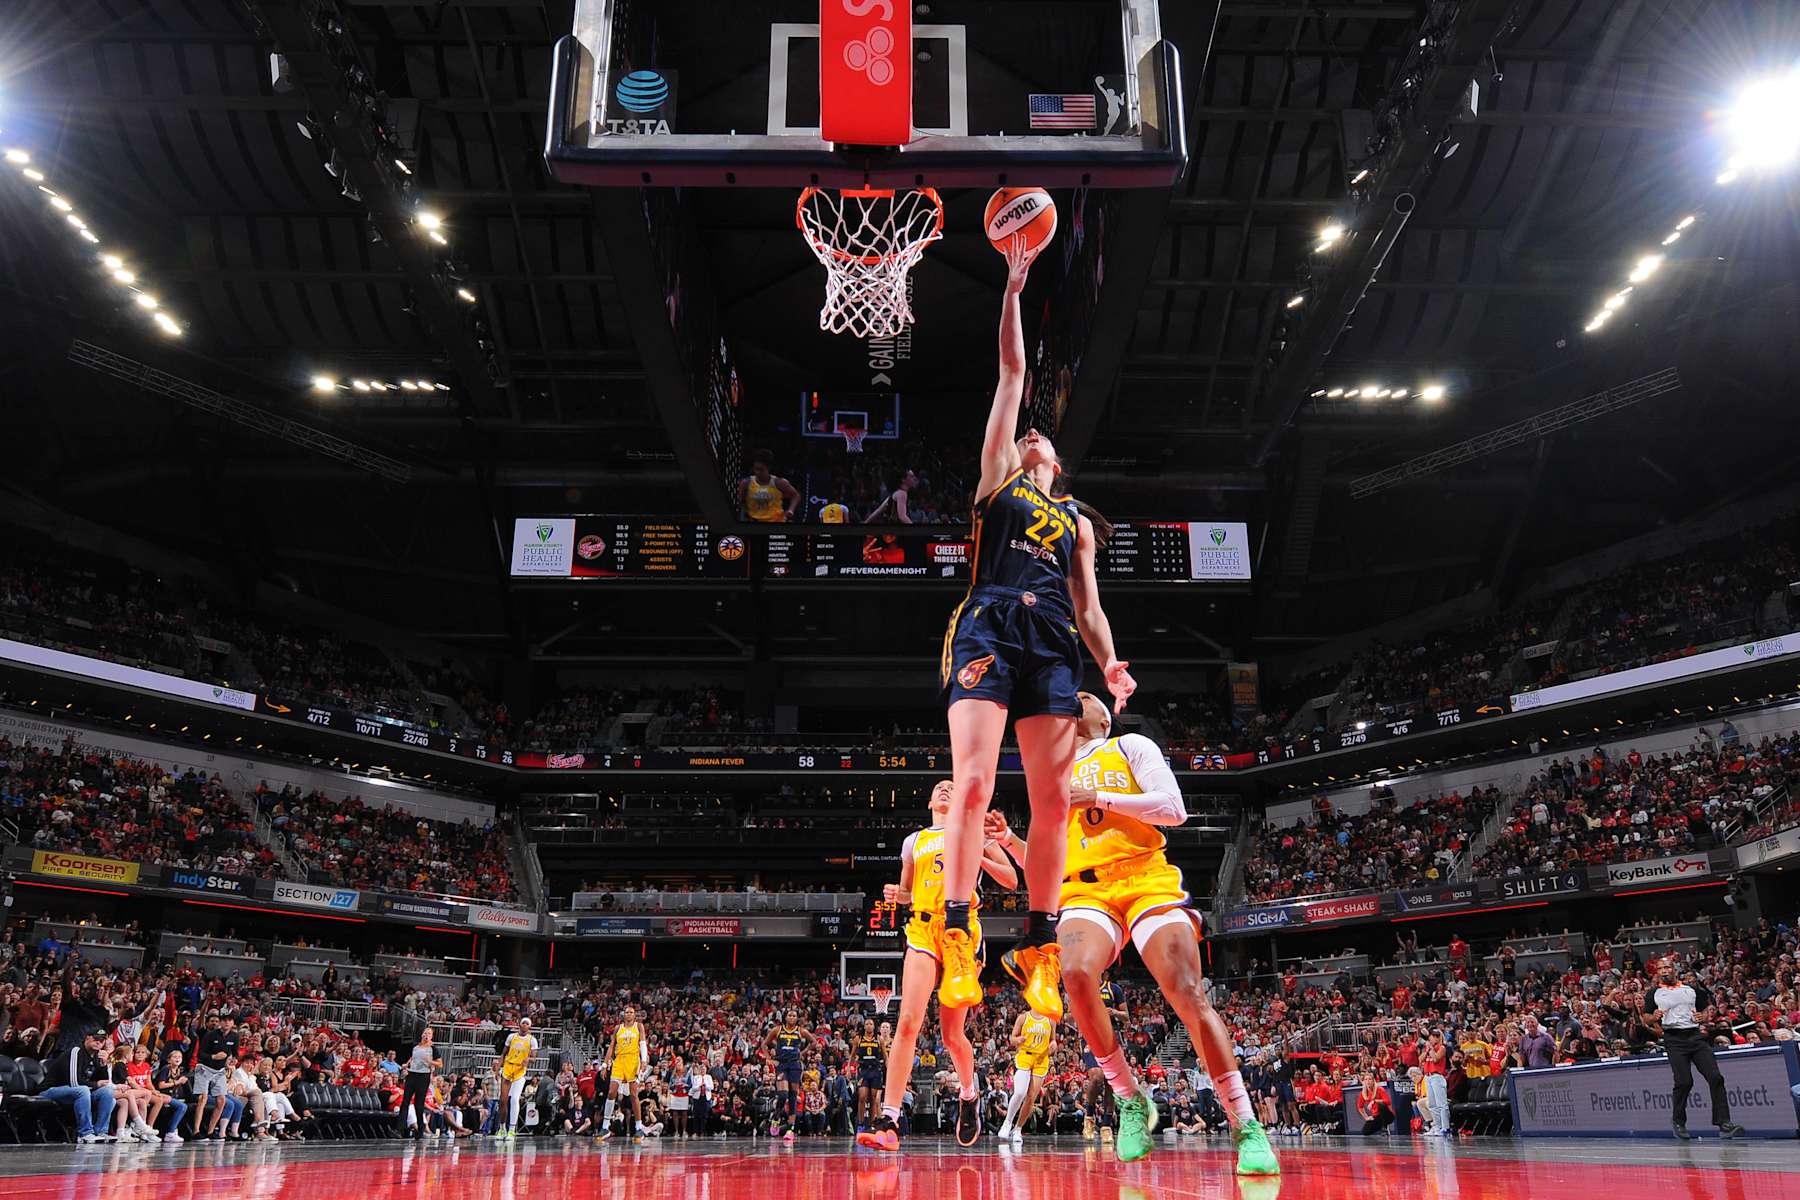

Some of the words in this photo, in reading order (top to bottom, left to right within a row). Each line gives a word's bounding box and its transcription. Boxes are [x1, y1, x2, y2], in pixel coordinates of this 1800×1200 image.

[994, 198, 1039, 230] Wilson
[1025, 509, 1065, 552] 22
[840, 567, 927, 575] #FEVERGAMENIGHT
[307, 713, 330, 725] 4/12
[1438, 714, 1460, 726] 7/16
[355, 723, 381, 736] 10/11
[1392, 725, 1408, 735] 4/6
[402, 733, 429, 746] 22/40
[1340, 734, 1367, 746] 22/49
[450, 744, 456, 752] 2
[476, 749, 486, 759] 13
[1314, 744, 1320, 752] 5
[502, 755, 513, 764] 26
[1258, 755, 1268, 764] 14
[1285, 750, 1295, 759] 11
[689, 758, 720, 766] INDIANA
[721, 758, 745, 766] FEVER
[798, 756, 814, 767] 58
[841, 759, 851, 768] 22
[879, 756, 907, 768] 5:54
[928, 760, 935, 768] 3
[1086, 807, 1104, 826] 0
[44, 854, 127, 874] Koorsen
[933, 853, 945, 874] 5
[41, 865, 62, 873] FIRE
[79, 870, 125, 880] SECURITY
[1609, 864, 1672, 881] KeyBank
[1503, 876, 1559, 896] SHIFT
[1567, 876, 1575, 886] 4
[277, 887, 333, 902] SECTION
[334, 894, 352, 905] 127
[874, 900, 897, 911] 5:53
[1306, 909, 1336, 918] STEAK
[1343, 901, 1376, 913] SHAKE
[478, 908, 507, 925] Bally
[508, 917, 530, 926] SPORTS
[870, 910, 895, 929] 21
[1223, 909, 1288, 928] SHIPSIGMA
[867, 1047, 872, 1056] 0
[1538, 1088, 1574, 1104] PUBLIC
[1590, 1091, 1642, 1113] Prevent.
[1540, 1102, 1576, 1118] HEALTH
[1542, 1117, 1577, 1127] DEPARTMENT
